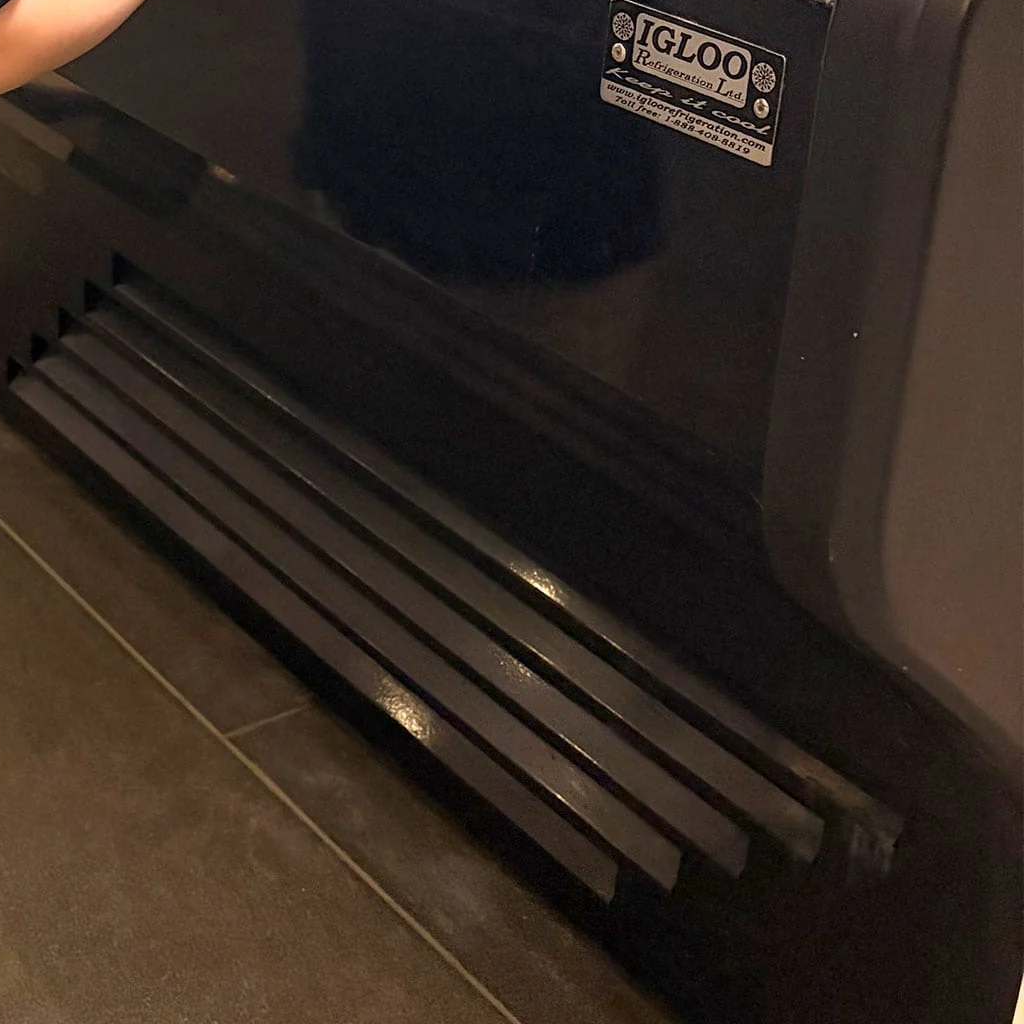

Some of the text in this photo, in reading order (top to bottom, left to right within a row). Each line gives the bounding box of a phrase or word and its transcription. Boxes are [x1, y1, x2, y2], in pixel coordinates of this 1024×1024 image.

[634, 48, 744, 102] Refrigeration Ltd.
[636, 19, 748, 80] IGLOO
[605, 67, 772, 135] Keep it cool
[607, 83, 766, 152] www.igloorefrigeration.com
[615, 95, 636, 109] Toll
[665, 116, 750, 154] 1-888-408-8819
